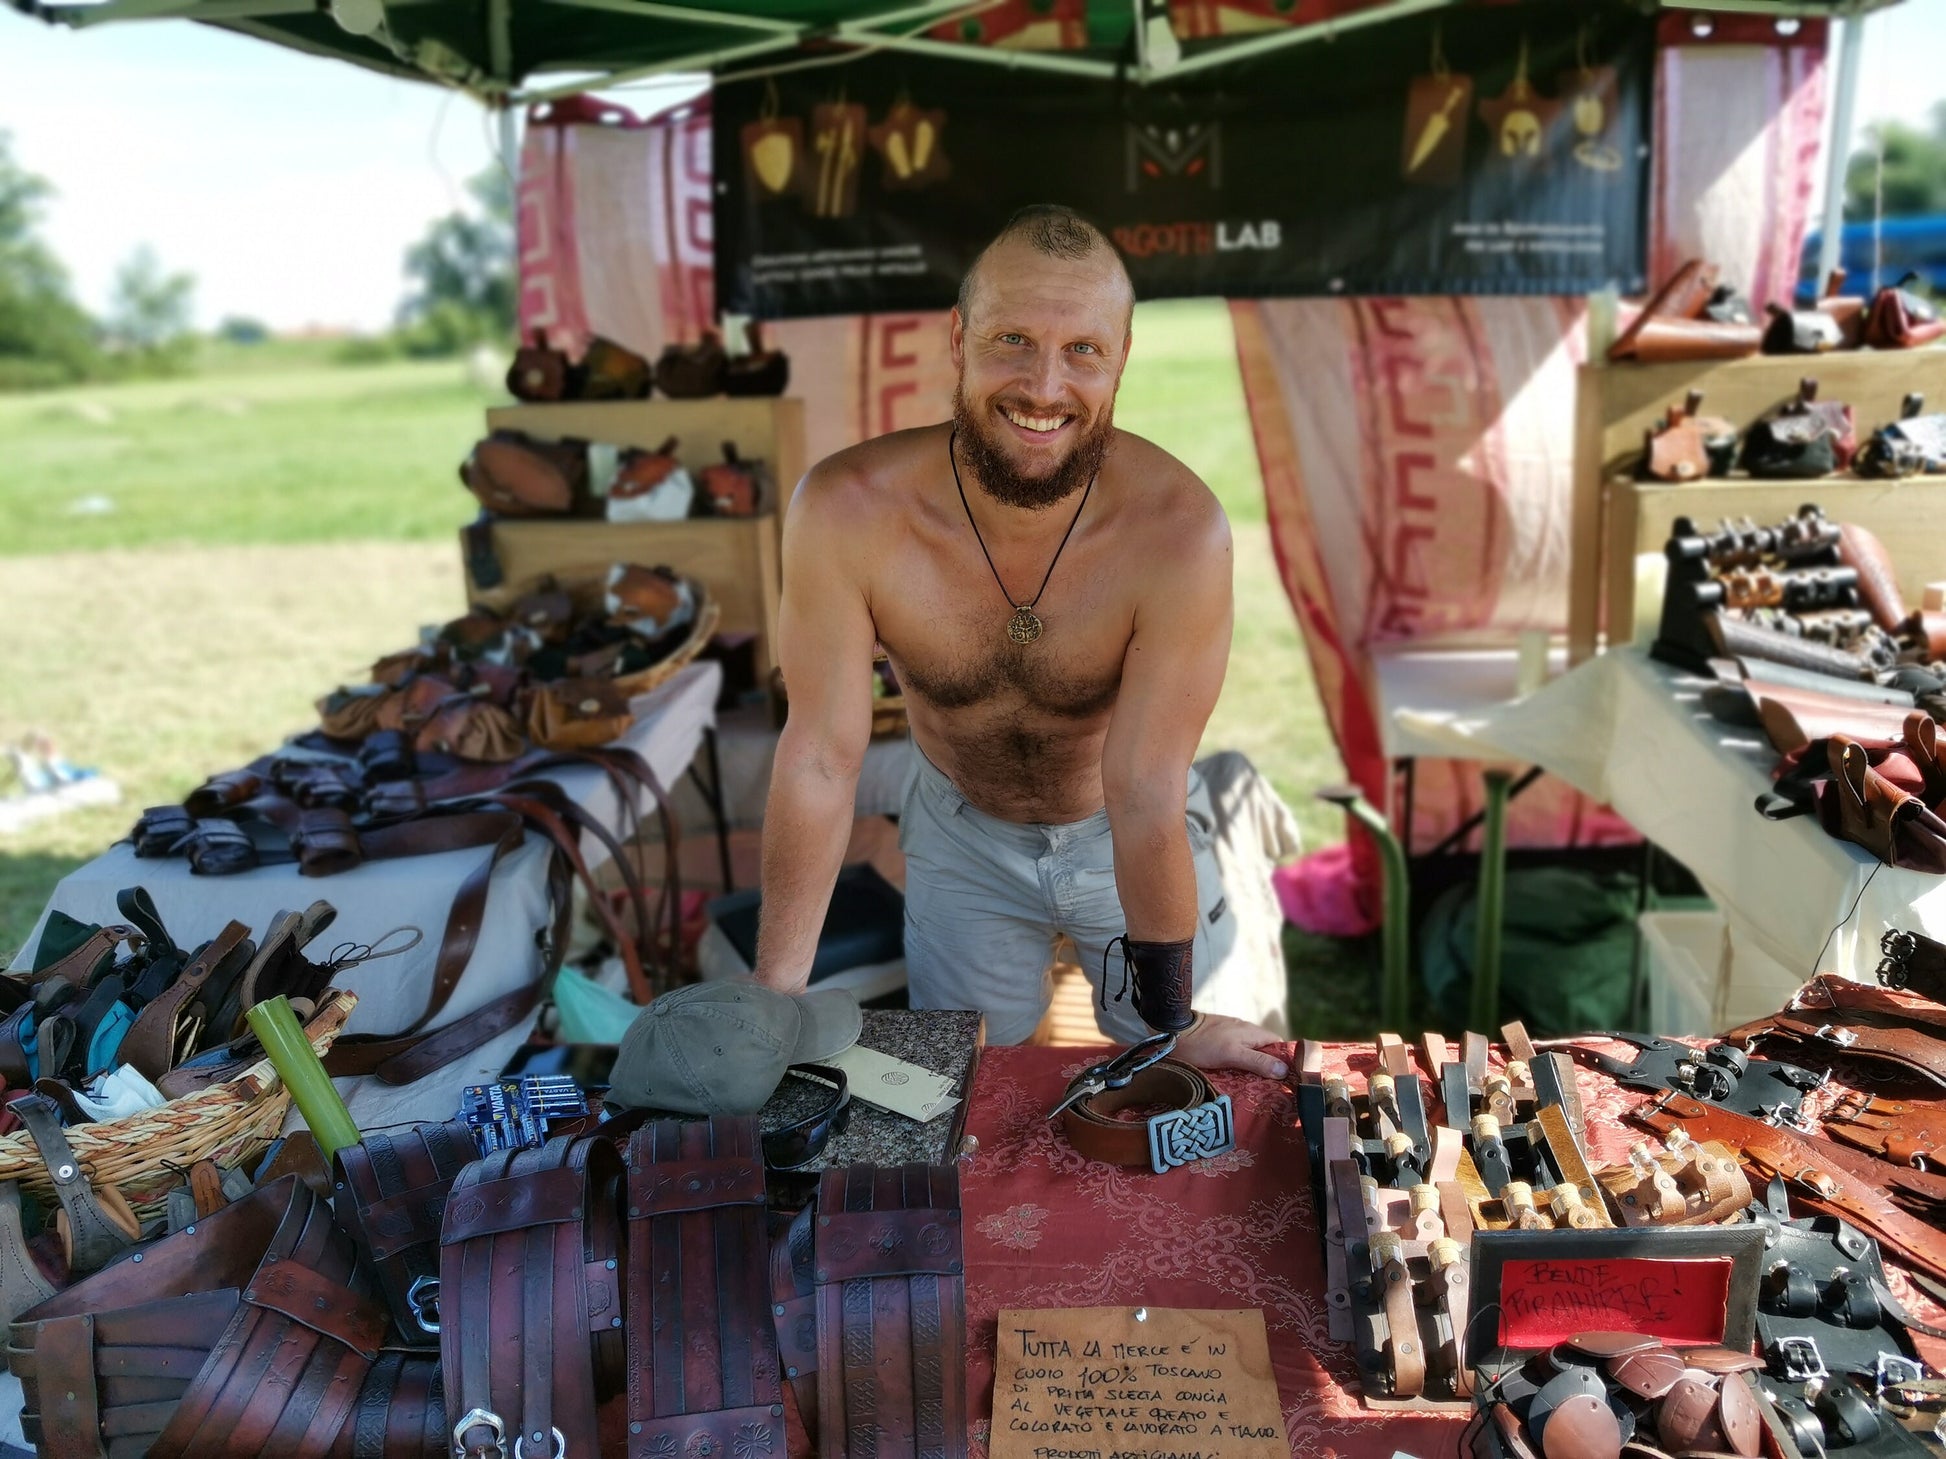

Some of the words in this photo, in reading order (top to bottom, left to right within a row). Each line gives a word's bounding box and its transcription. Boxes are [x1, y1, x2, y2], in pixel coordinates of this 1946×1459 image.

[489, 1084, 505, 1114] VARTA
[1014, 1329, 1072, 1359] TUTTA
[1082, 1340, 1101, 1358] LA
[1112, 1343, 1170, 1359] MERCE
[1208, 1343, 1226, 1356] IN
[1014, 1367, 1063, 1380] CUOIO
[1077, 1366, 1138, 1388] 100%
[1145, 1363, 1222, 1379] TOSCANO
[1011, 1397, 1032, 1413] AL
[1054, 1402, 1141, 1420] VEGETALE
[1218, 1411, 1230, 1420] E
[1009, 1417, 1092, 1434] COLORATO
[1105, 1421, 1113, 1432] E
[1123, 1422, 1198, 1435] LAVORATO
[1210, 1424, 1222, 1435] A
